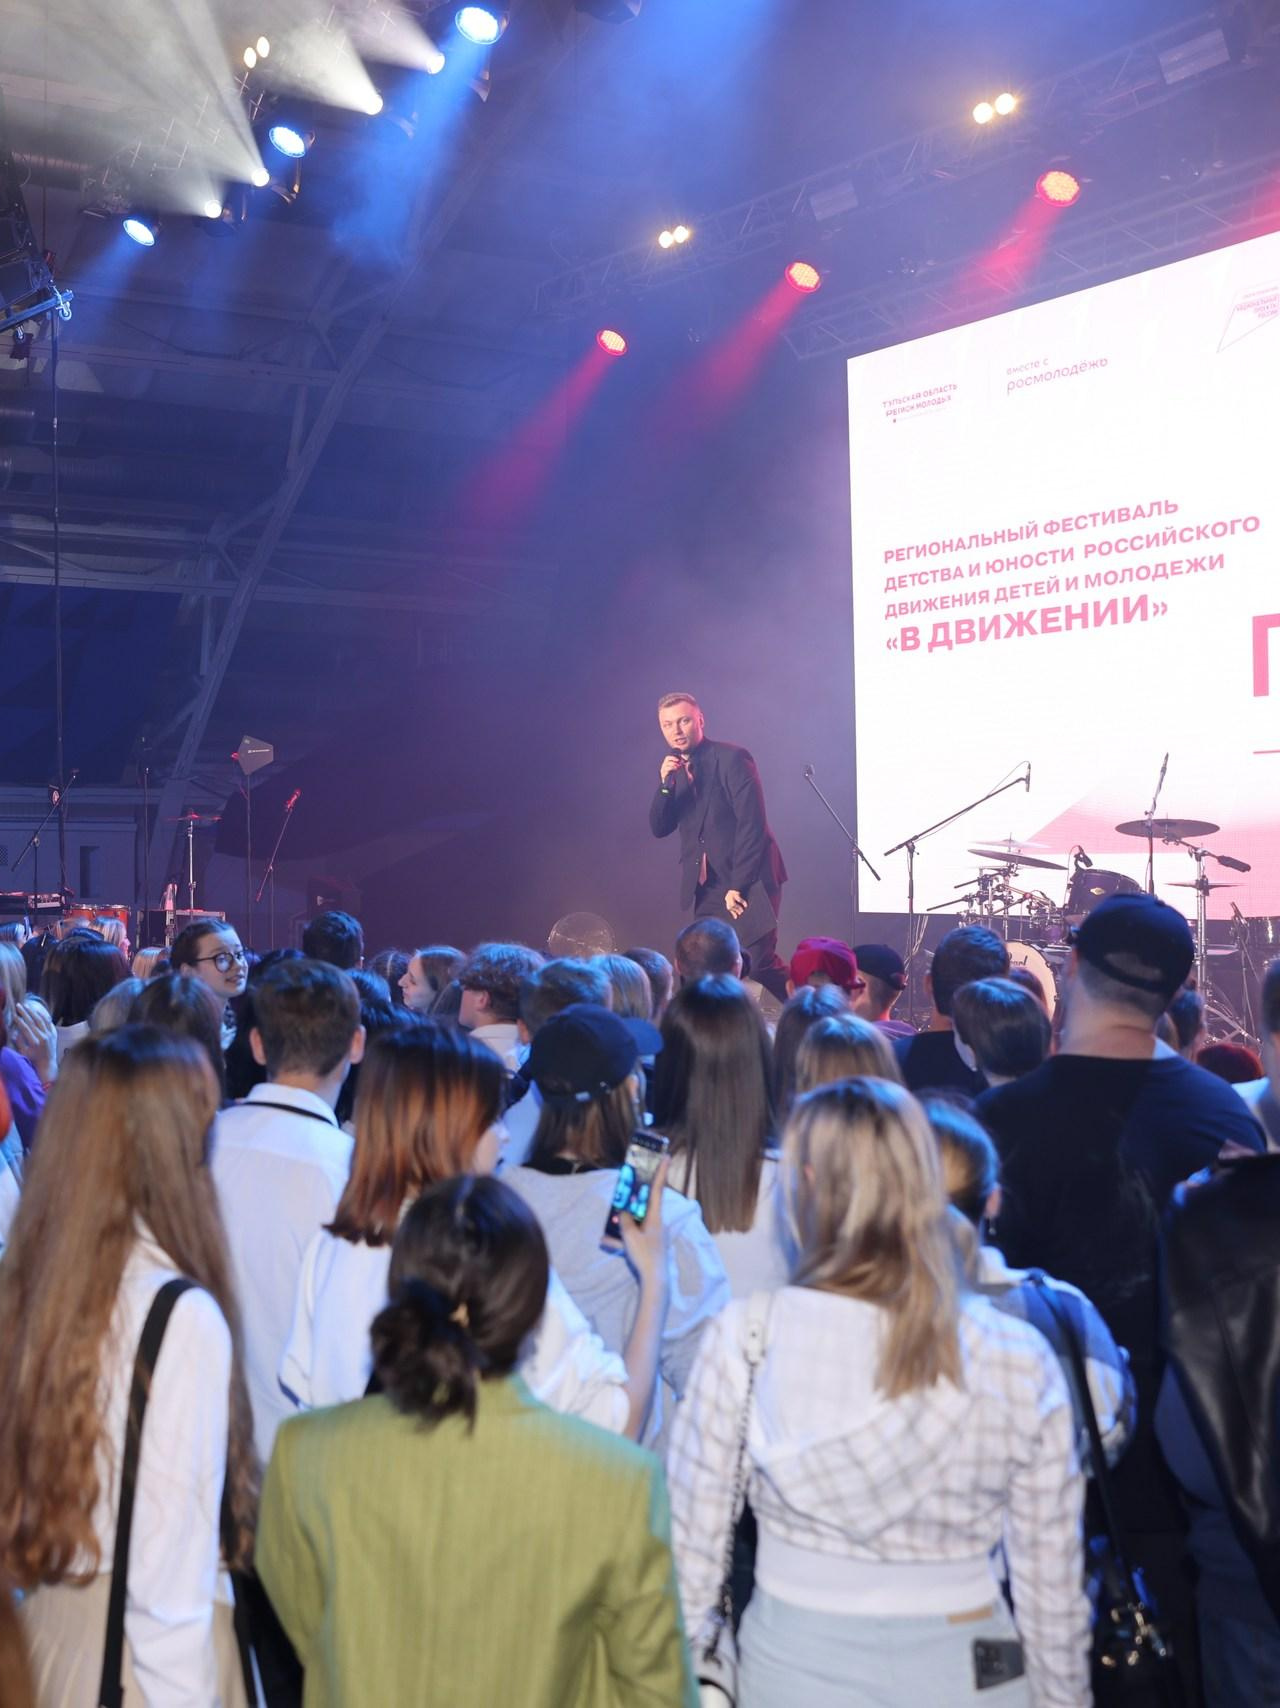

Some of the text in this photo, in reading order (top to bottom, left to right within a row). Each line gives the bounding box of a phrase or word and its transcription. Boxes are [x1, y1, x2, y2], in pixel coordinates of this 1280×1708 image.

[884, 499, 1179, 564] РЕГИОНАЛЬНЫЙ ФЕСТИВАЛЬ
[884, 516, 1261, 593] ДЕТСТВА И ЮНОСТИ РОССИЙСКОГО
[884, 553, 1225, 620] ДВИЖЕНИЯ ДЕТЕЙ И МОЛОДЕЖИ
[886, 594, 1169, 653] «В ДВИЖЕНИИ»
